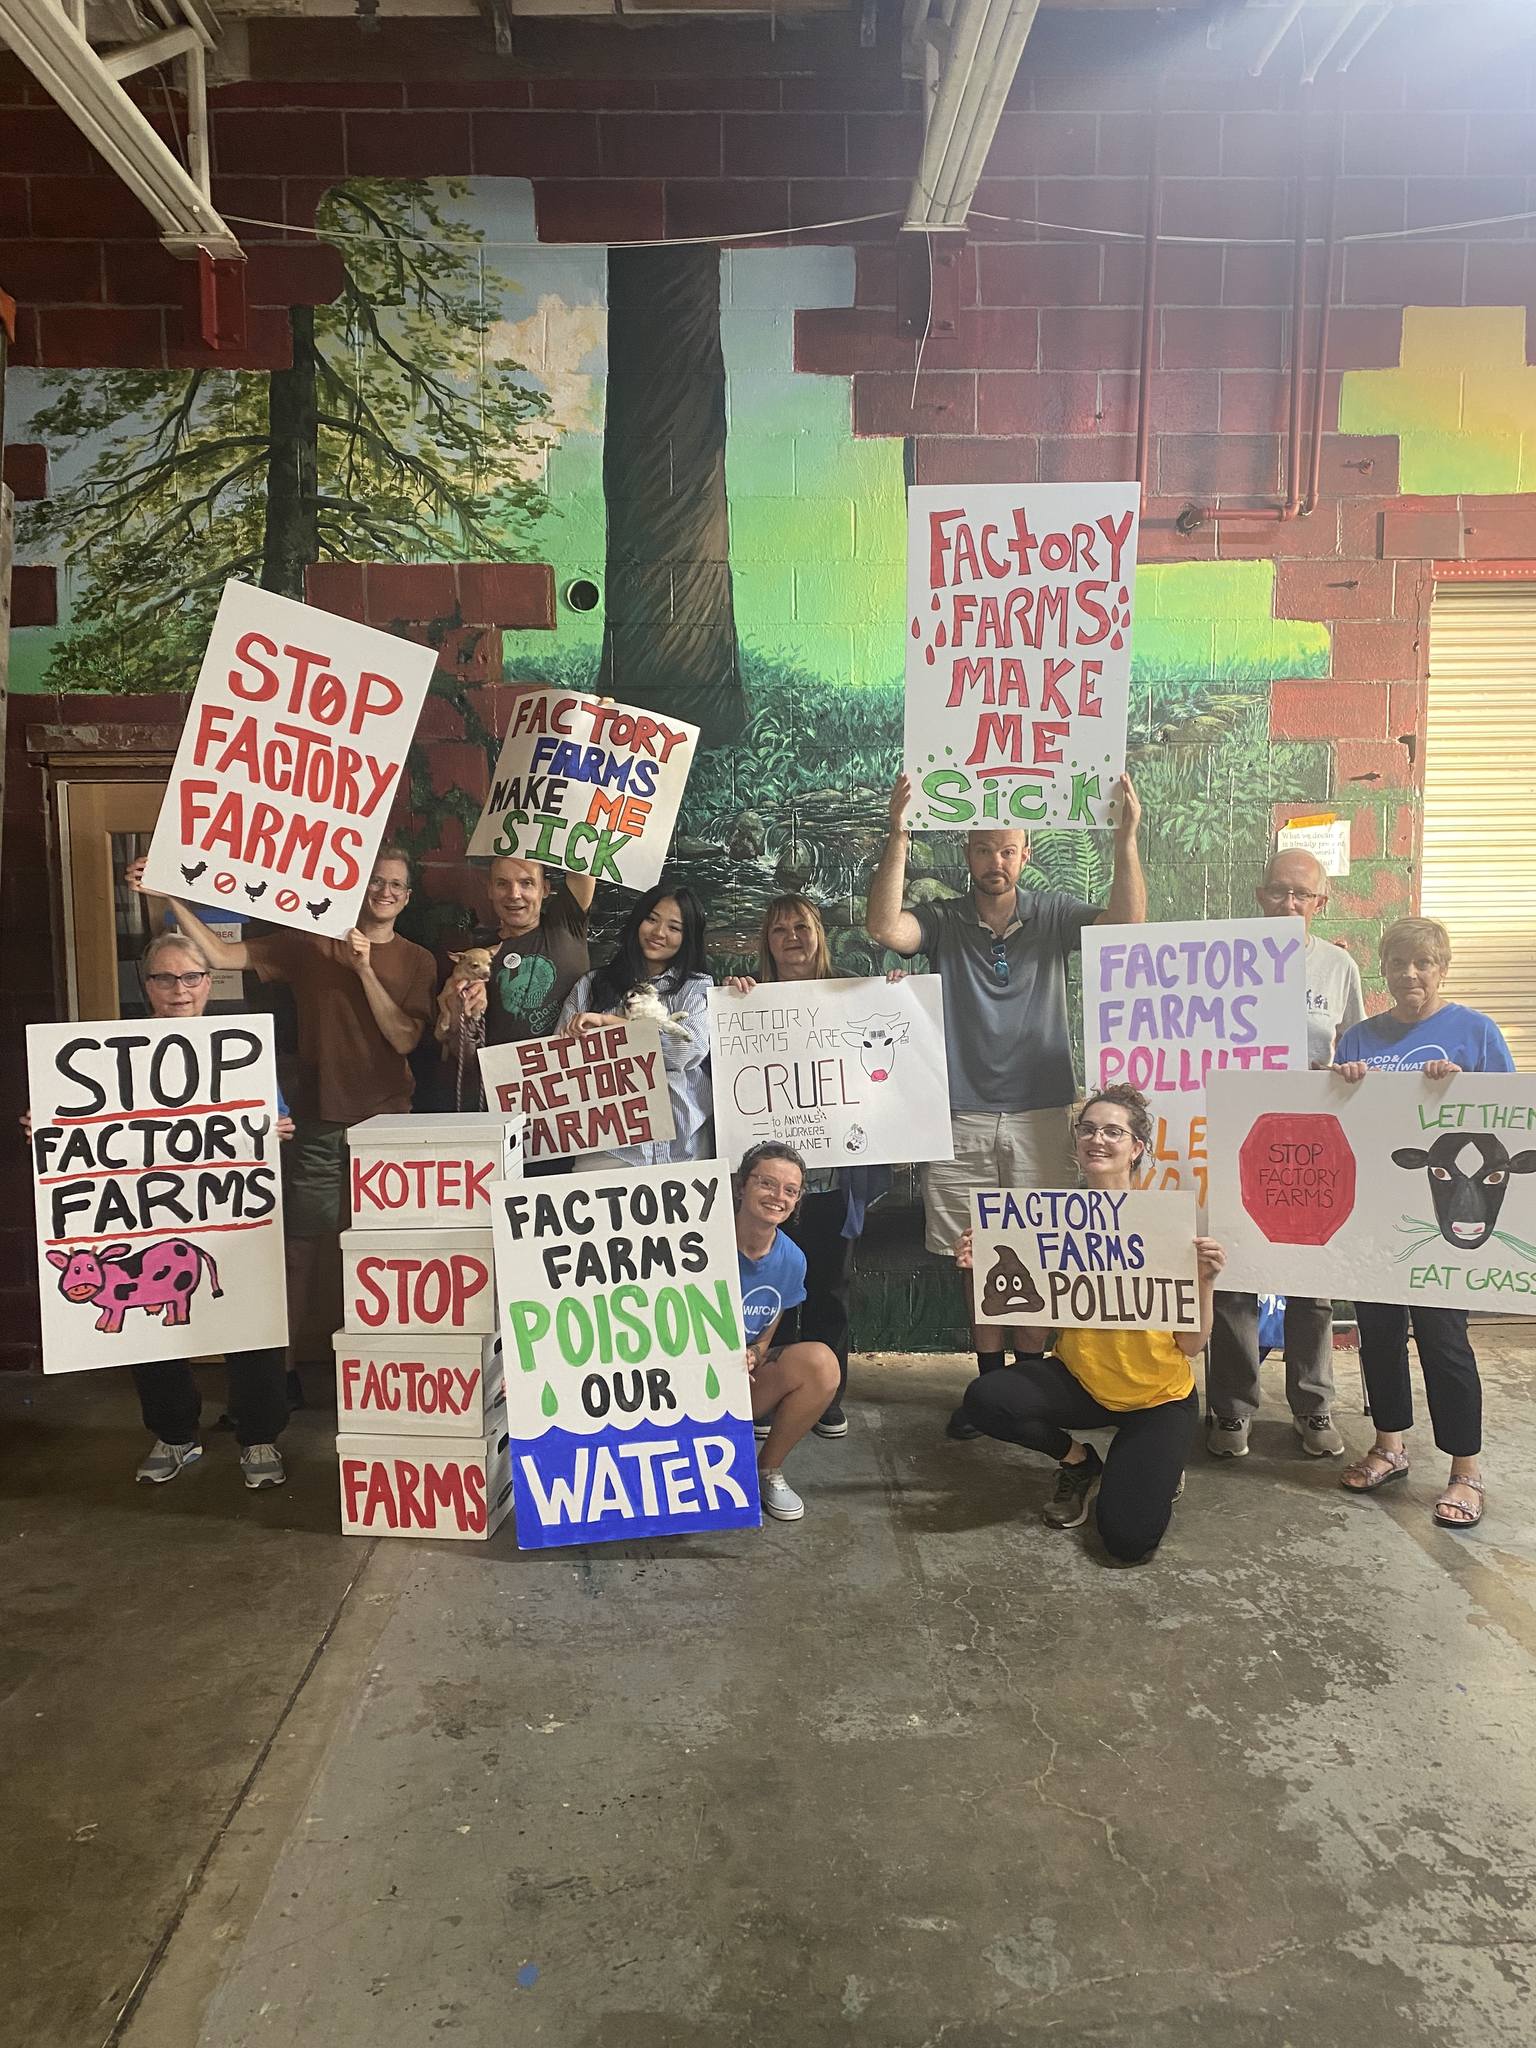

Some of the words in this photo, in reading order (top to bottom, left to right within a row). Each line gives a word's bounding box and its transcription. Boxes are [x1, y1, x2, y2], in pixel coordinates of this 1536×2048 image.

[952, 580, 1111, 650] FARMS
[228, 632, 403, 735] STOP
[945, 656, 1103, 719] MAKE
[512, 697, 687, 763] FACTORY
[965, 712, 1070, 766] ME
[193, 704, 399, 818] FACTORY
[529, 737, 659, 797] FARMS
[180, 779, 364, 890] FARMS
[488, 776, 568, 815] MAKE
[585, 788, 652, 837] ME
[493, 810, 632, 883] SICK
[1100, 937, 1300, 992] FACTORY
[717, 1007, 819, 1032] FACTORY
[720, 1032, 788, 1056] FARMS
[806, 1029, 841, 1049] ARE
[1099, 994, 1257, 1044] FARMS
[54, 1029, 263, 1116] STOP
[516, 1026, 628, 1077] STOP
[496, 1051, 656, 1113] FACTORY
[733, 1059, 860, 1115] CRUEL
[33, 1114, 270, 1174] FACTORY
[784, 1114, 820, 1125] ANIMALS
[785, 1126, 825, 1138] WORKERS
[1418, 1104, 1475, 1130] LET
[1259, 1168, 1340, 1187] FACTORY
[1269, 1143, 1323, 1165] STOP
[51, 1167, 276, 1239] FARMS
[352, 1157, 495, 1212] KOTEK
[505, 1177, 718, 1240] FACTORY
[977, 1191, 1128, 1230] FACTORY
[1266, 1188, 1333, 1208] FARMS
[542, 1231, 708, 1289] FARMS
[1037, 1231, 1145, 1272] FARMS
[1409, 1264, 1461, 1289] EAT
[355, 1255, 488, 1326] STOP
[743, 1305, 778, 1316] WATCH
[1048, 1271, 1194, 1324] POLLUTE
[509, 1279, 741, 1372] POISON
[342, 1358, 480, 1415] FACTORY
[581, 1368, 677, 1418] OUR
[342, 1459, 486, 1533] FARMS
[519, 1435, 750, 1527] WATER
